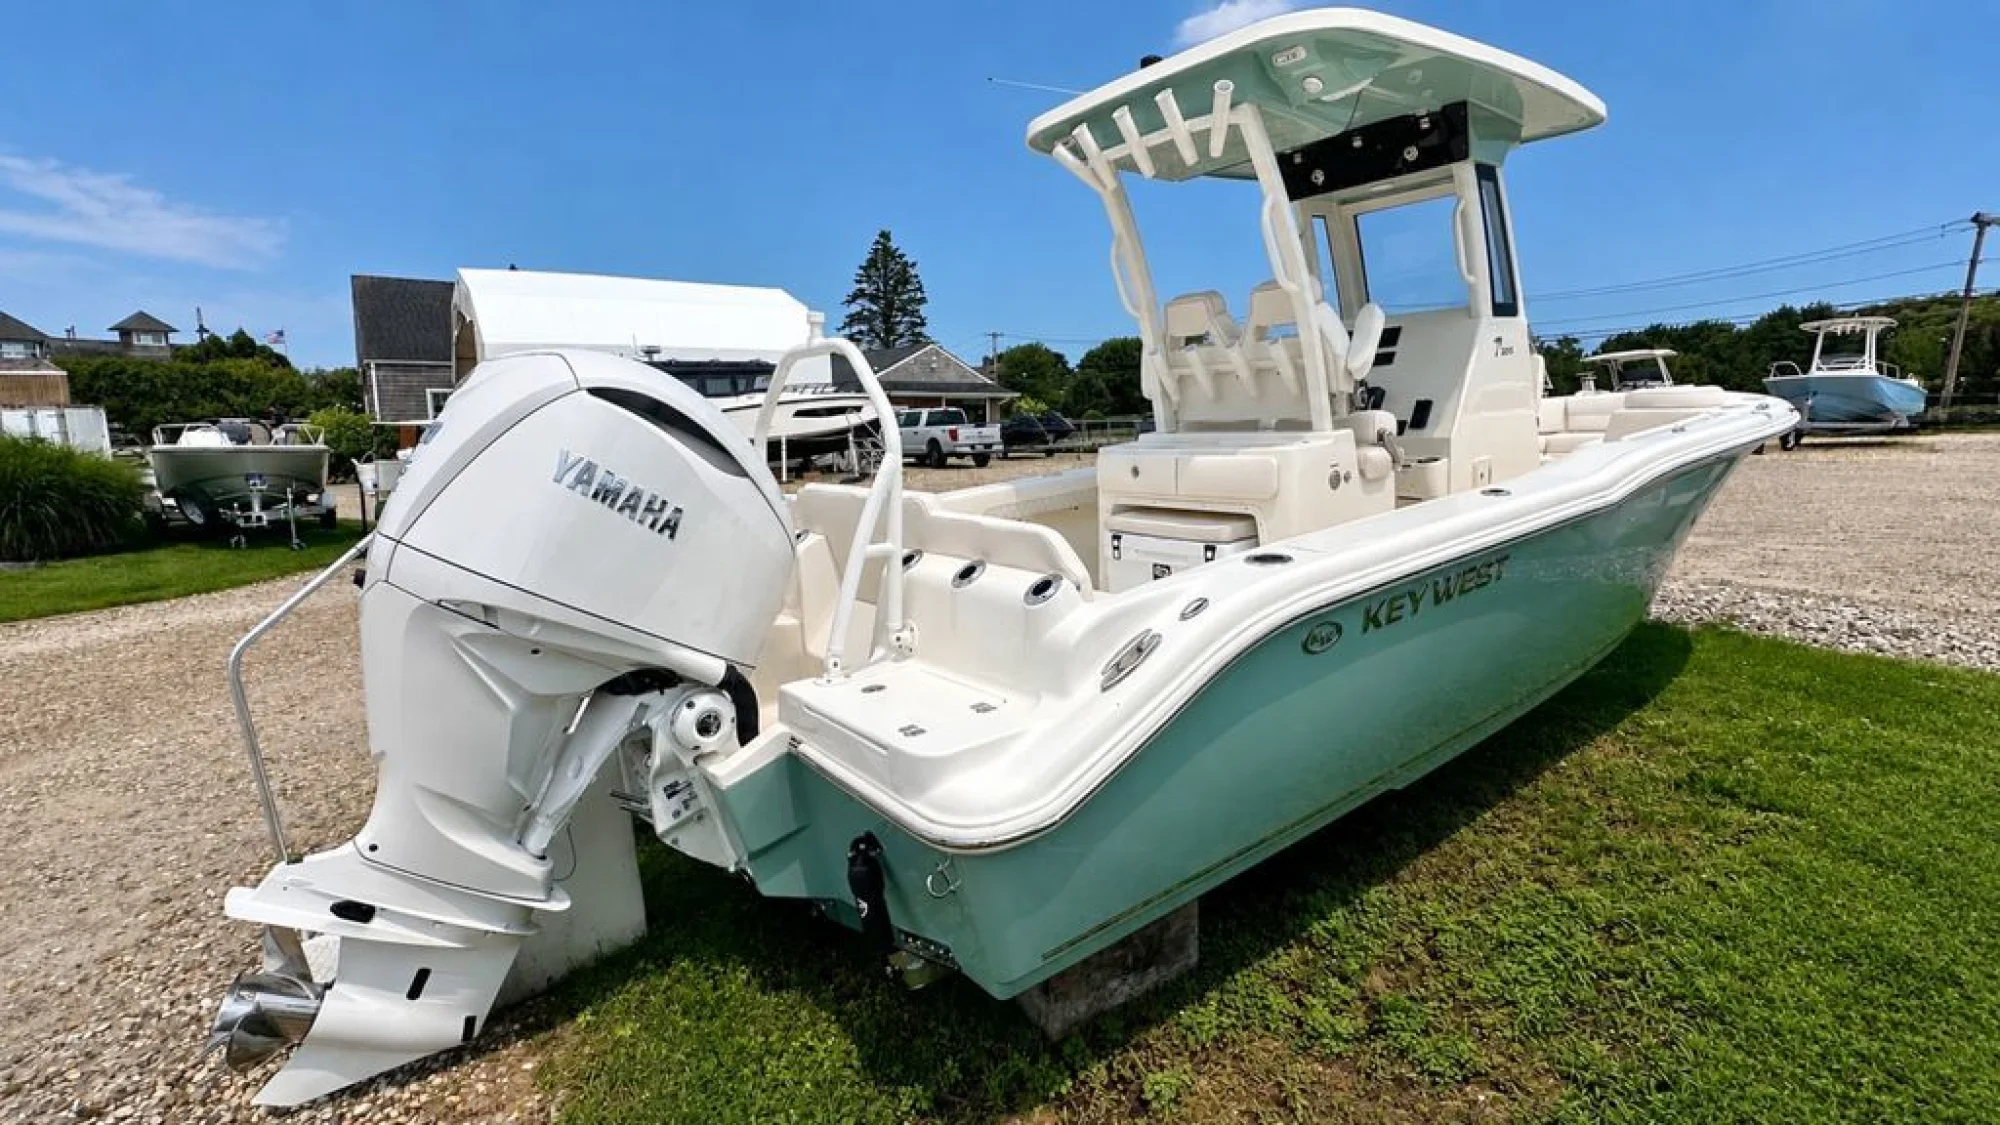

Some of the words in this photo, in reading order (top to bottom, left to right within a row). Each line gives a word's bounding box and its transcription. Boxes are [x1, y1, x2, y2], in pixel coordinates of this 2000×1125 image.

[553, 449, 684, 540] YAMAHA
[1362, 583, 1429, 634] KEY
[1433, 554, 1511, 606] WEST
